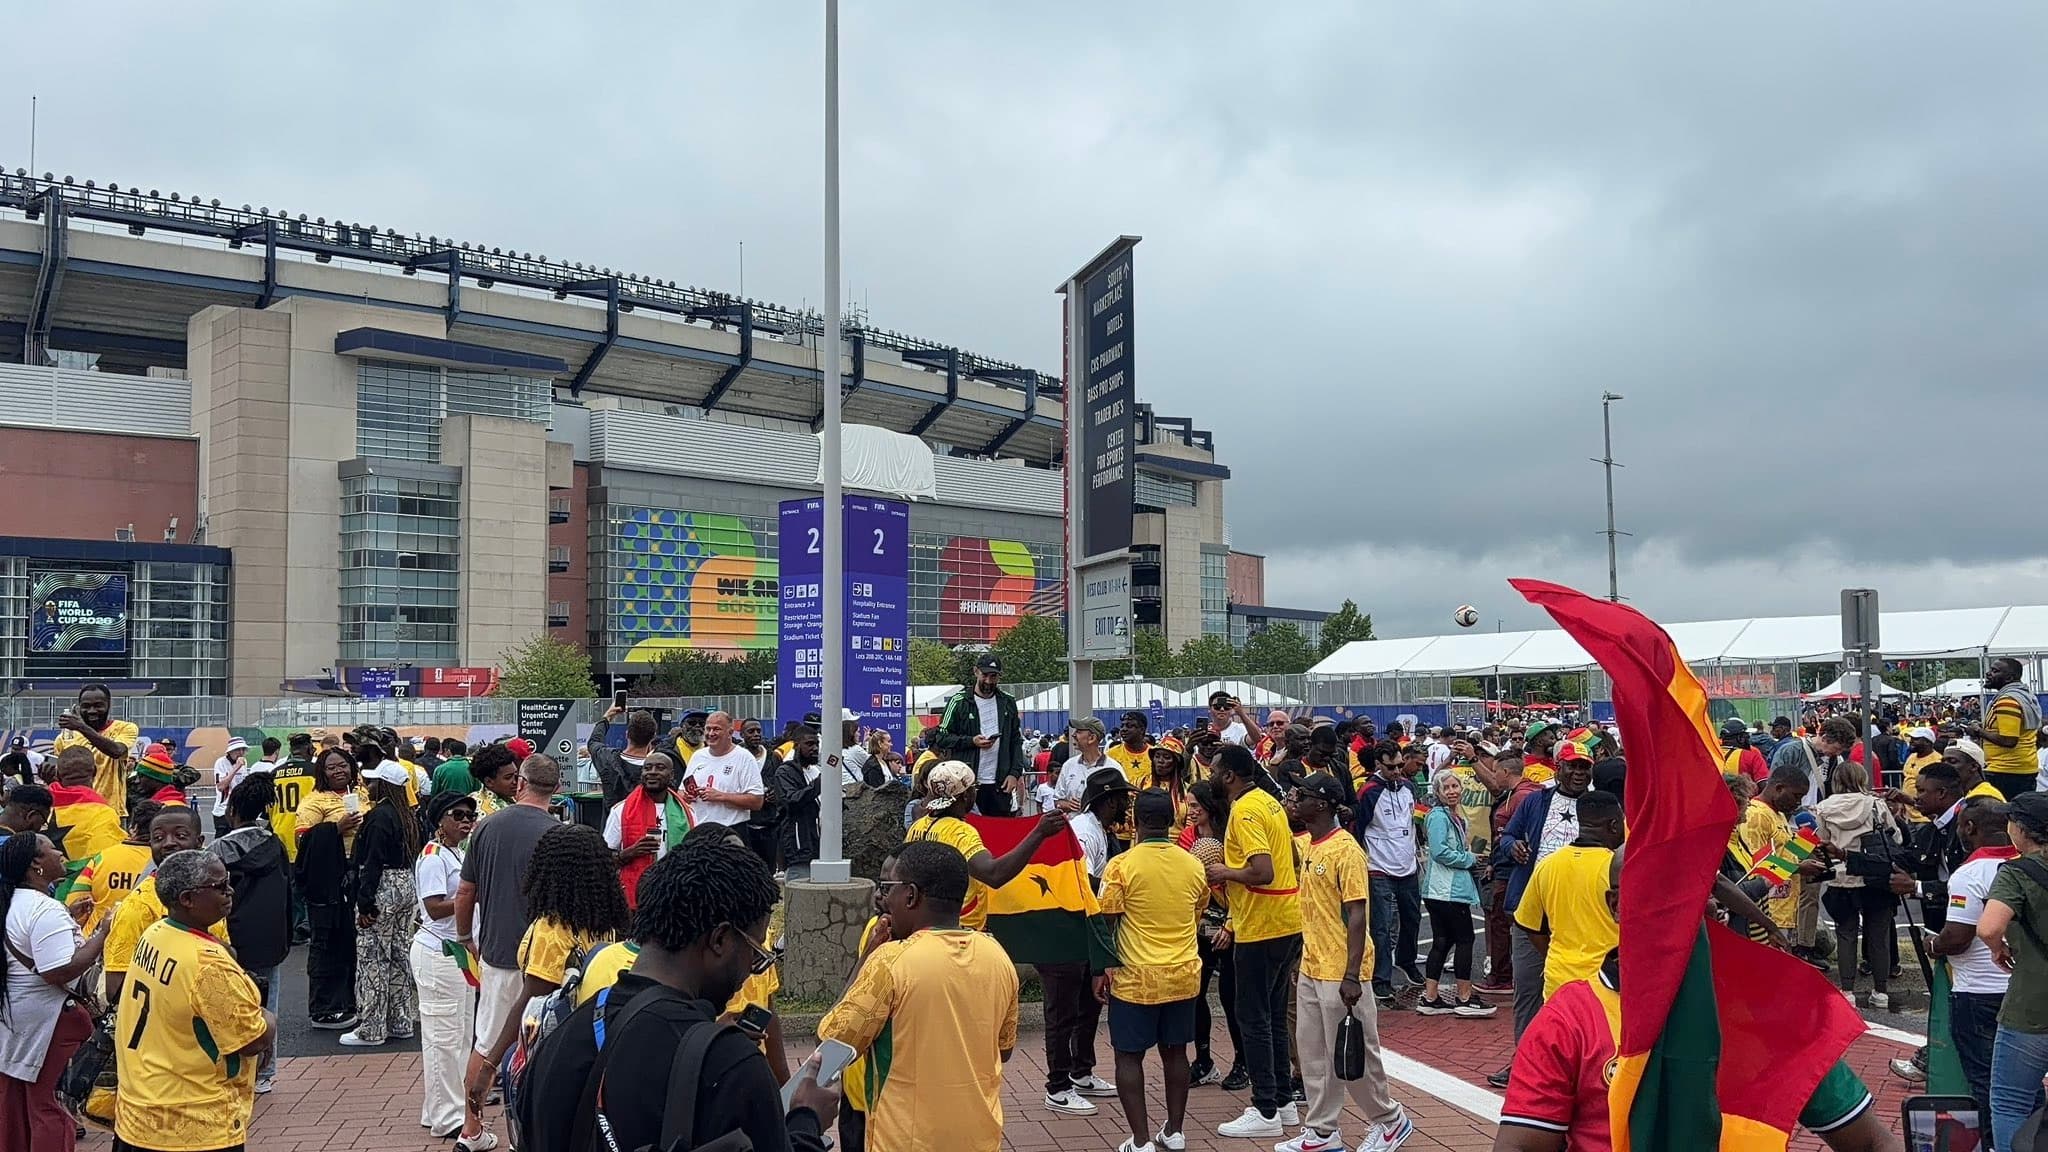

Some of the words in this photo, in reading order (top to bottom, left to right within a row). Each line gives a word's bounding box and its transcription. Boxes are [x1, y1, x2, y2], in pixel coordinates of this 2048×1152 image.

[1108, 265, 1123, 289] SOUTH
[1093, 283, 1123, 317] MARKETPLACE
[1107, 313, 1123, 336] HOTELS
[1090, 356, 1099, 374] CVS
[1100, 341, 1124, 369] PHARMACY
[1087, 384, 1098, 403] BASS
[1099, 379, 1108, 397] PRO
[1109, 370, 1124, 391] SHOPS
[1095, 405, 1111, 426] TRADER
[1112, 399, 1124, 418] JOE'S
[1107, 428, 1124, 448] CENTER
[1097, 454, 1106, 470] FOR
[1107, 446, 1124, 466] SPORTS
[1092, 463, 1124, 489] PERFORMANCE
[874, 503, 885, 511] FIFA
[807, 527, 820, 554] 2
[873, 528, 885, 555] 2
[717, 578, 749, 596] WE
[753, 580, 779, 597] AR
[58, 600, 80, 608] FIFA
[58, 608, 94, 616] WORLD
[717, 600, 777, 614] BOSTO
[853, 600, 876, 609] Hospitality
[960, 600, 1016, 616] #FIFAWorldCup
[58, 616, 77, 624] CUP
[78, 617, 113, 625] 2026
[784, 622, 803, 630] Storage
[806, 621, 823, 629] Orang
[852, 620, 876, 628] Experience
[1096, 616, 1106, 636] EXIT
[1107, 616, 1114, 635] TO
[885, 667, 902, 675] Parking
[792, 682, 818, 690] Hospitality
[880, 678, 902, 686] Rideshare
[395, 686, 405, 697] 22
[521, 703, 558, 711] HealthCare
[521, 728, 547, 736] Parking
[286, 767, 304, 776] SOLO
[276, 782, 300, 814] 10
[127, 979, 151, 1050] 7
